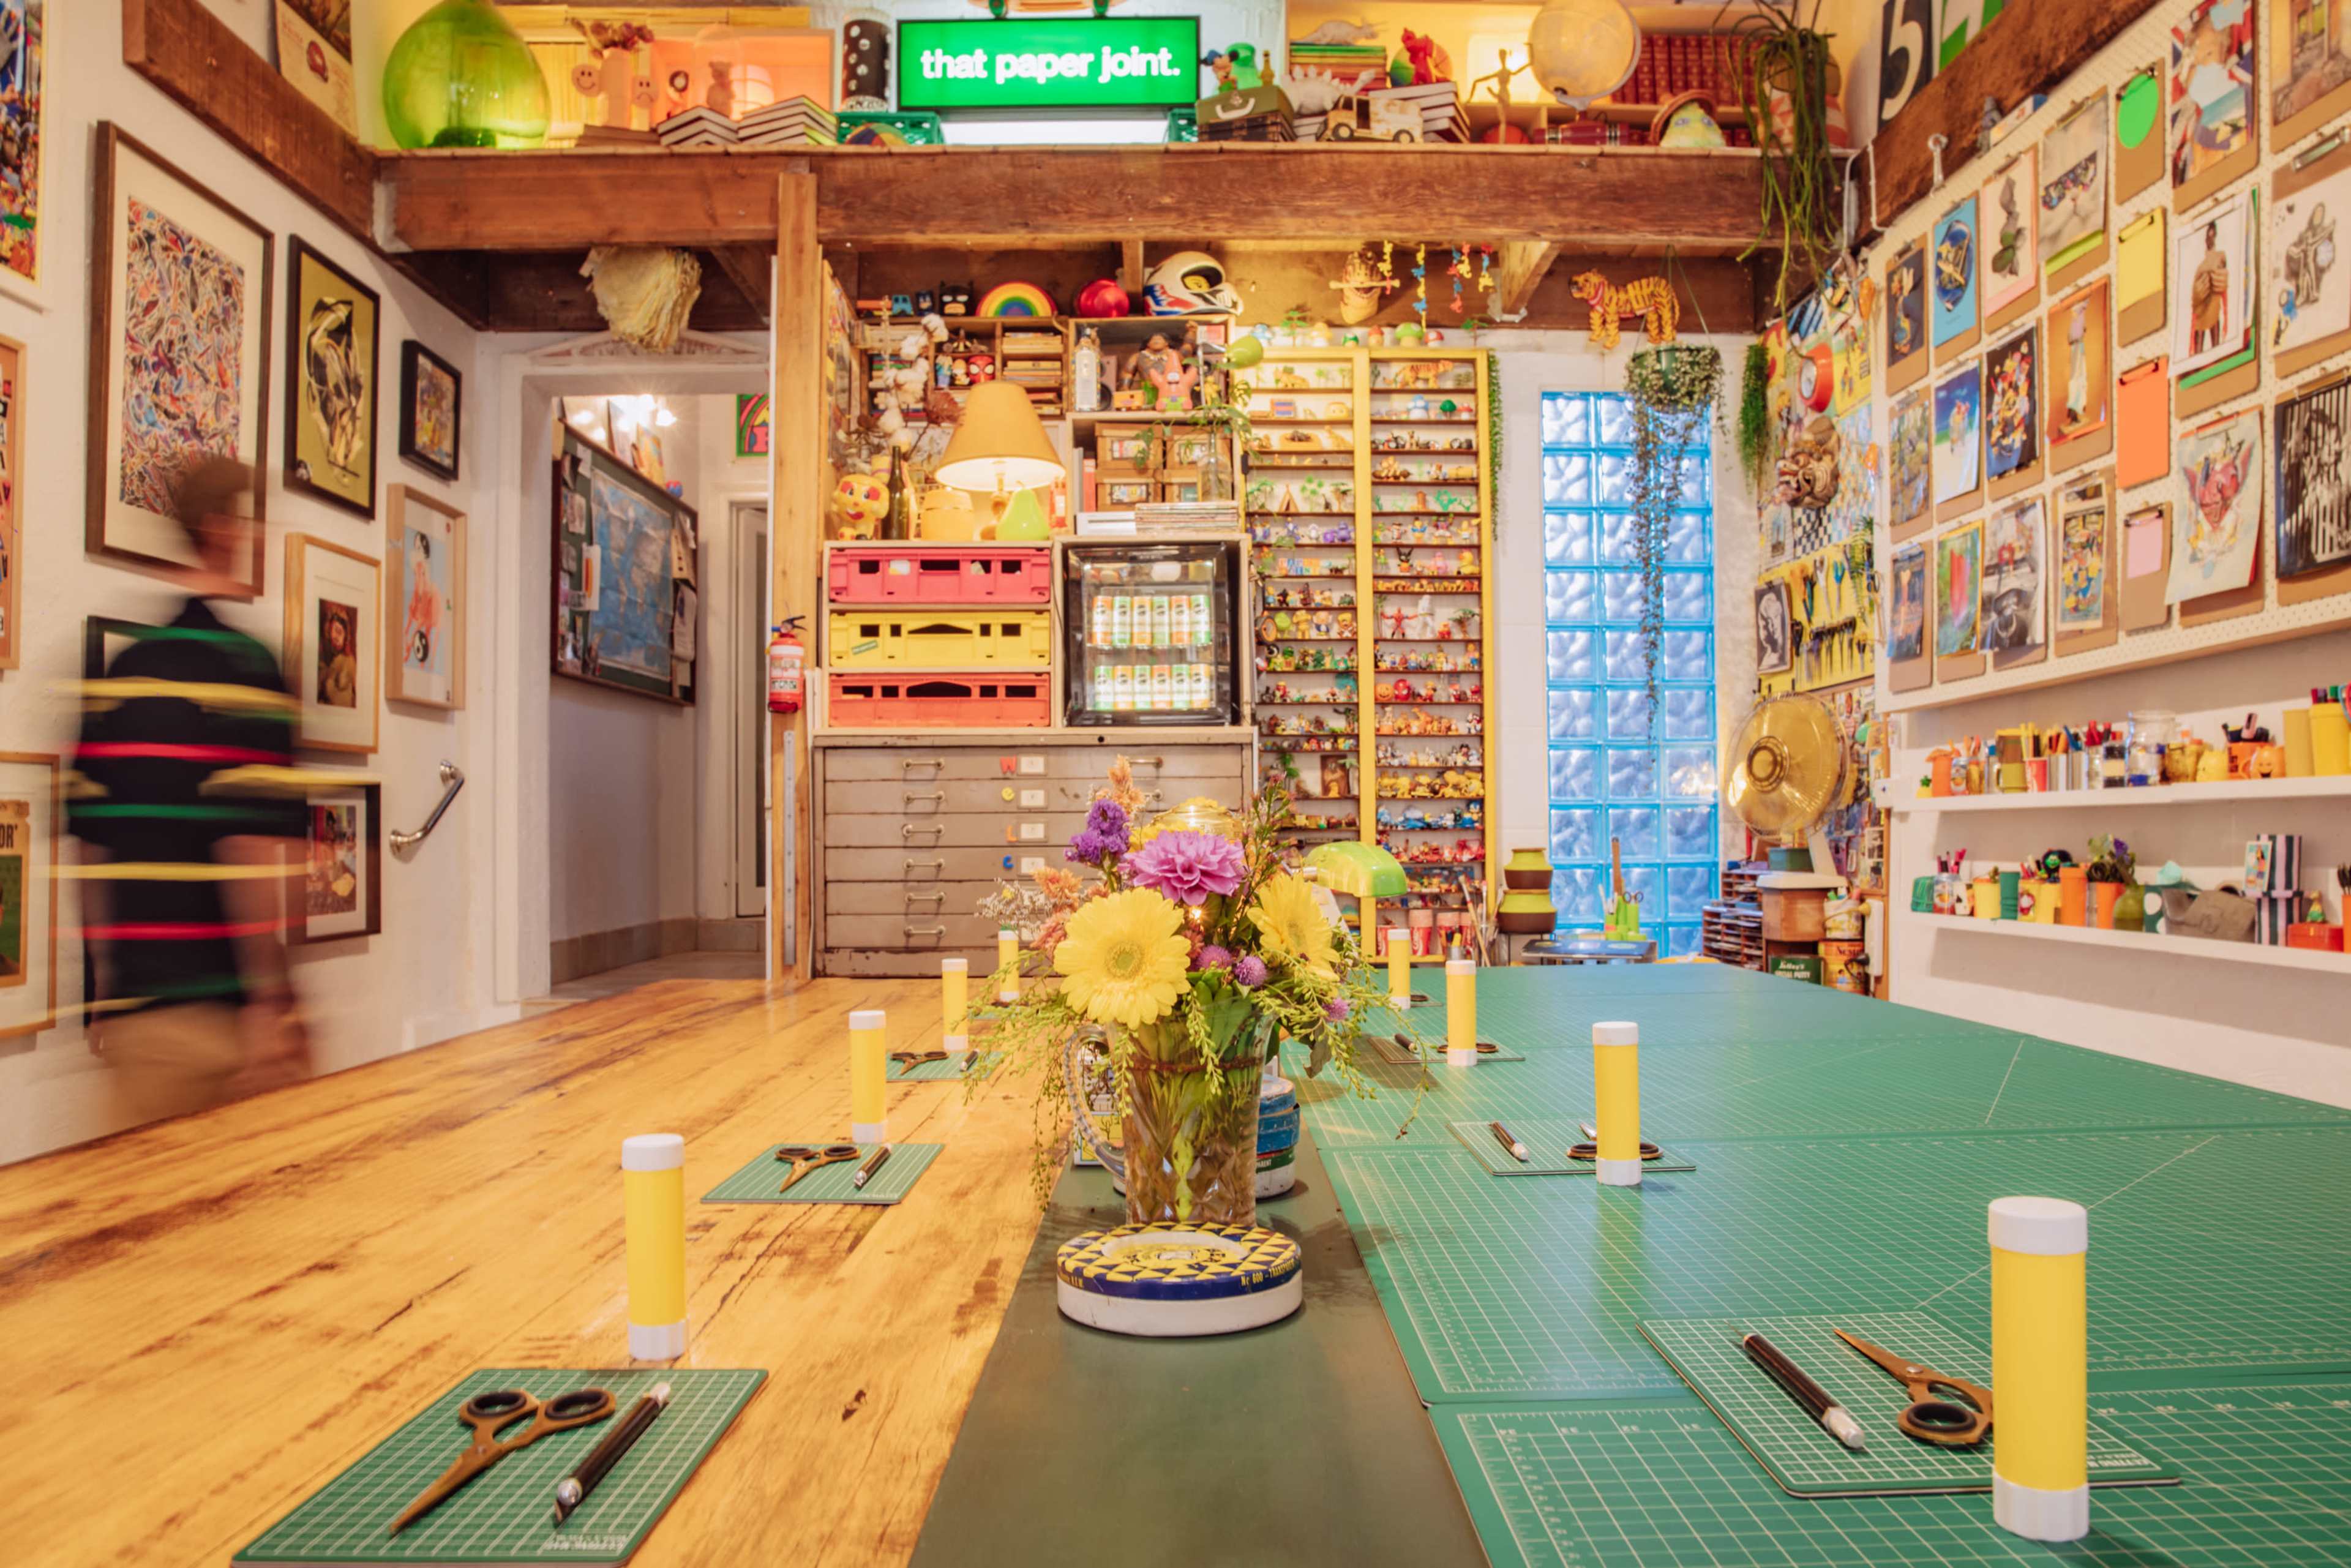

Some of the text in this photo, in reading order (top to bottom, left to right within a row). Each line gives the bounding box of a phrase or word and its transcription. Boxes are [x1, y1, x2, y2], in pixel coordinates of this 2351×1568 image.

[920, 46, 1180, 84] that paper joint.
[1881, 0, 1924, 121] 5
[999, 755, 1017, 775] W
[1006, 825, 1018, 842] L
[1002, 854, 1014, 869] C
